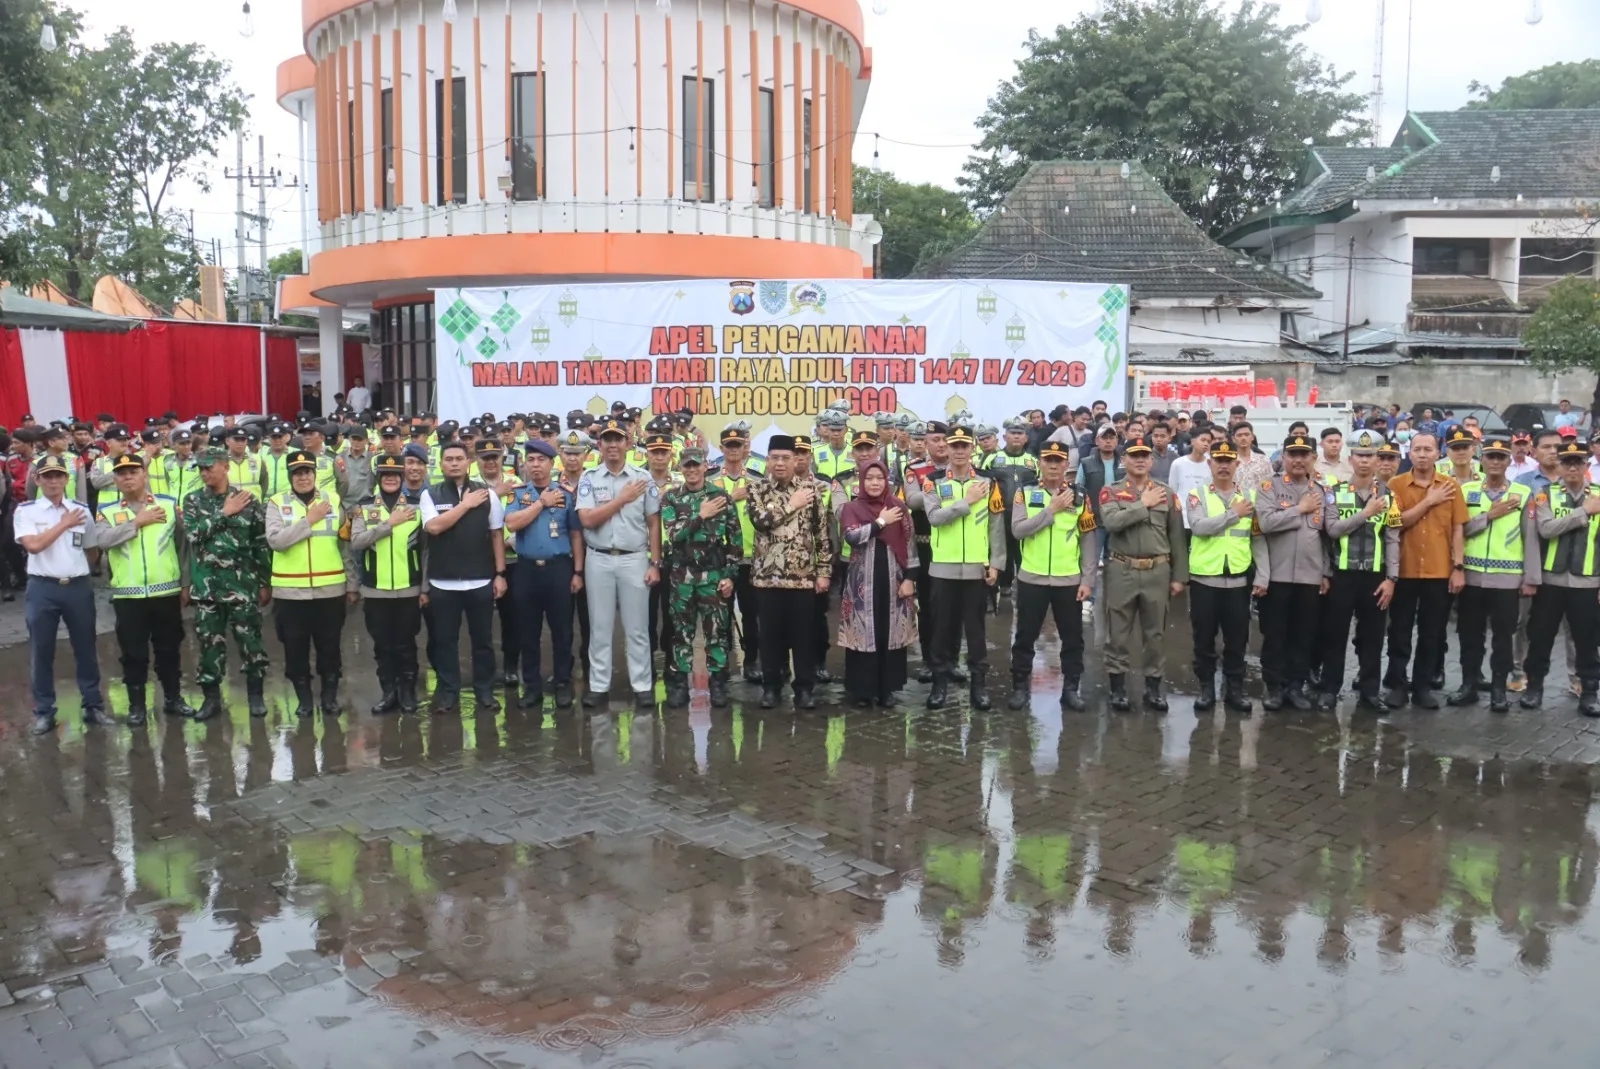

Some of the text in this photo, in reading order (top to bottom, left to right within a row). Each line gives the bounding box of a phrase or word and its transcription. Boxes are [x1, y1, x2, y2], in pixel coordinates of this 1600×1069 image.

[649, 325, 926, 355] APEL PENGAMANAN
[472, 360, 559, 387] MALAM
[562, 359, 652, 386] TAKBIR
[656, 357, 716, 384] HARI
[719, 357, 786, 383] RAYA
[789, 357, 847, 383] IDUL
[850, 357, 916, 384] FITRI
[919, 358, 979, 385] 1447
[651, 386, 717, 416] KOTA
